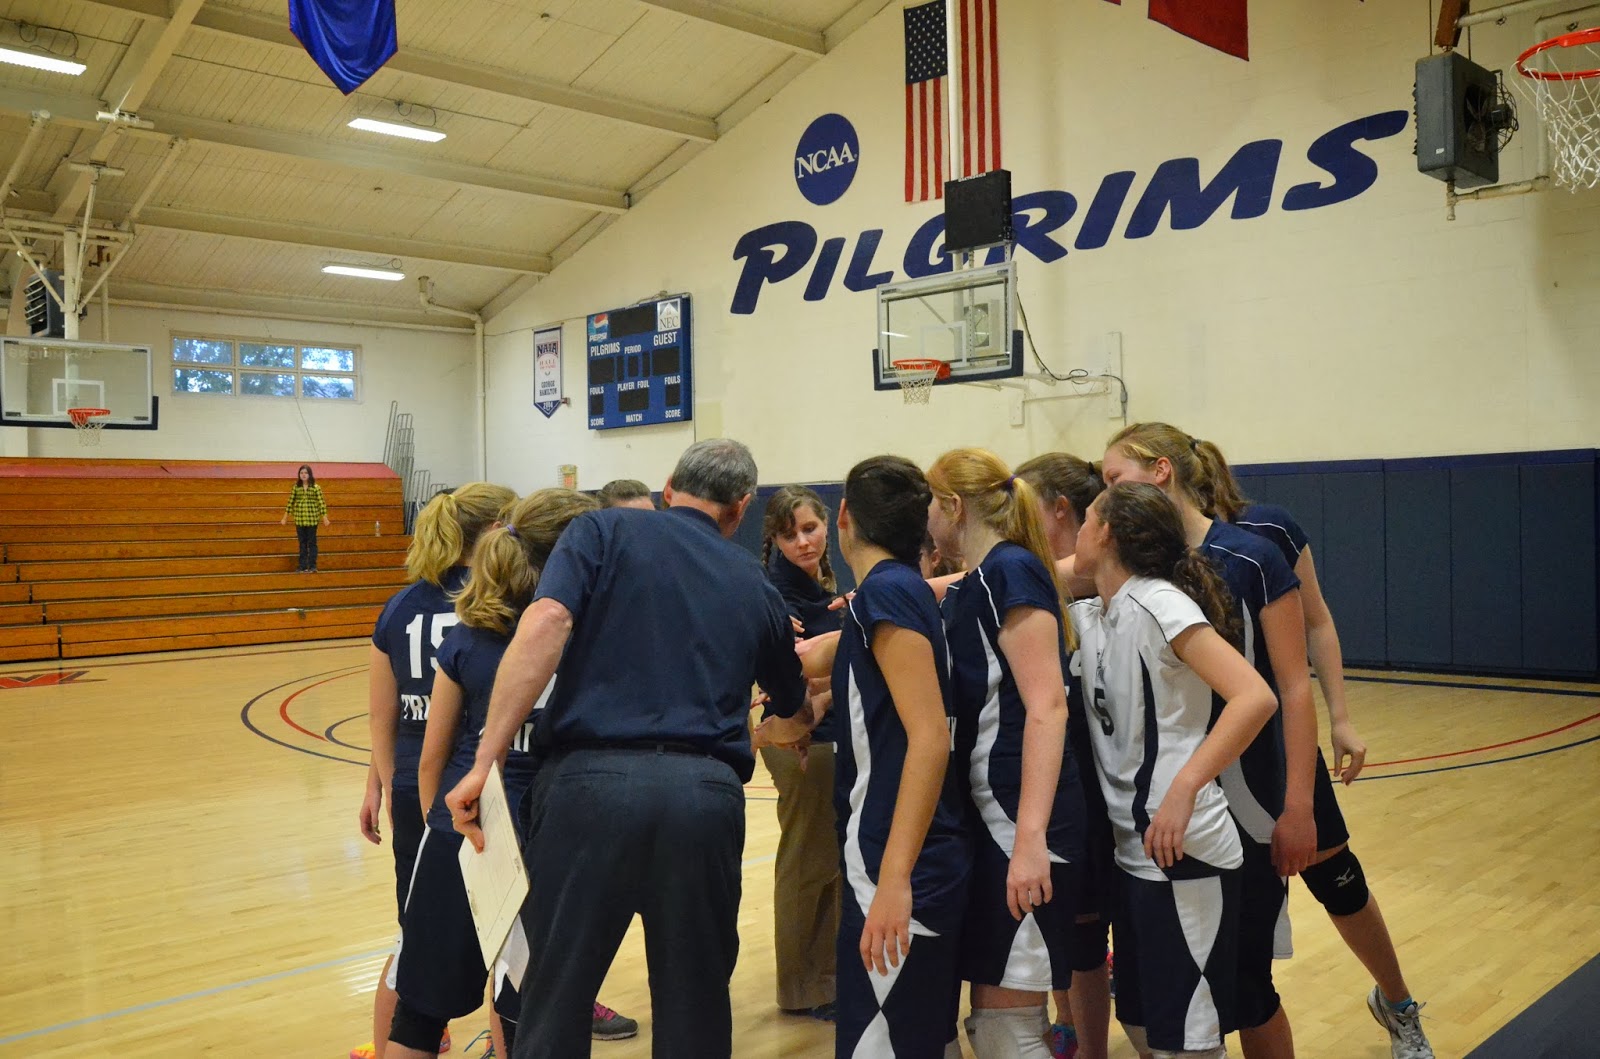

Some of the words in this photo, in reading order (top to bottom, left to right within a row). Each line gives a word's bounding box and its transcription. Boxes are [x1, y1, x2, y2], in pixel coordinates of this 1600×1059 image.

[796, 141, 856, 179] NCAA
[731, 110, 1409, 314] PILGRIMS
[660, 316, 679, 329] NEC
[653, 332, 677, 346] GUEST
[590, 342, 620, 356] PILGRIMS
[624, 344, 642, 355] PERIOD
[617, 382, 635, 391] PLAYER
[637, 379, 650, 389] FOUL
[664, 376, 680, 384] FOULS
[590, 387, 604, 395] FOULS
[625, 413, 643, 423] MATCH
[665, 409, 681, 419] SCORE
[590, 418, 605, 427] SCORE
[1093, 687, 1115, 736] 5
